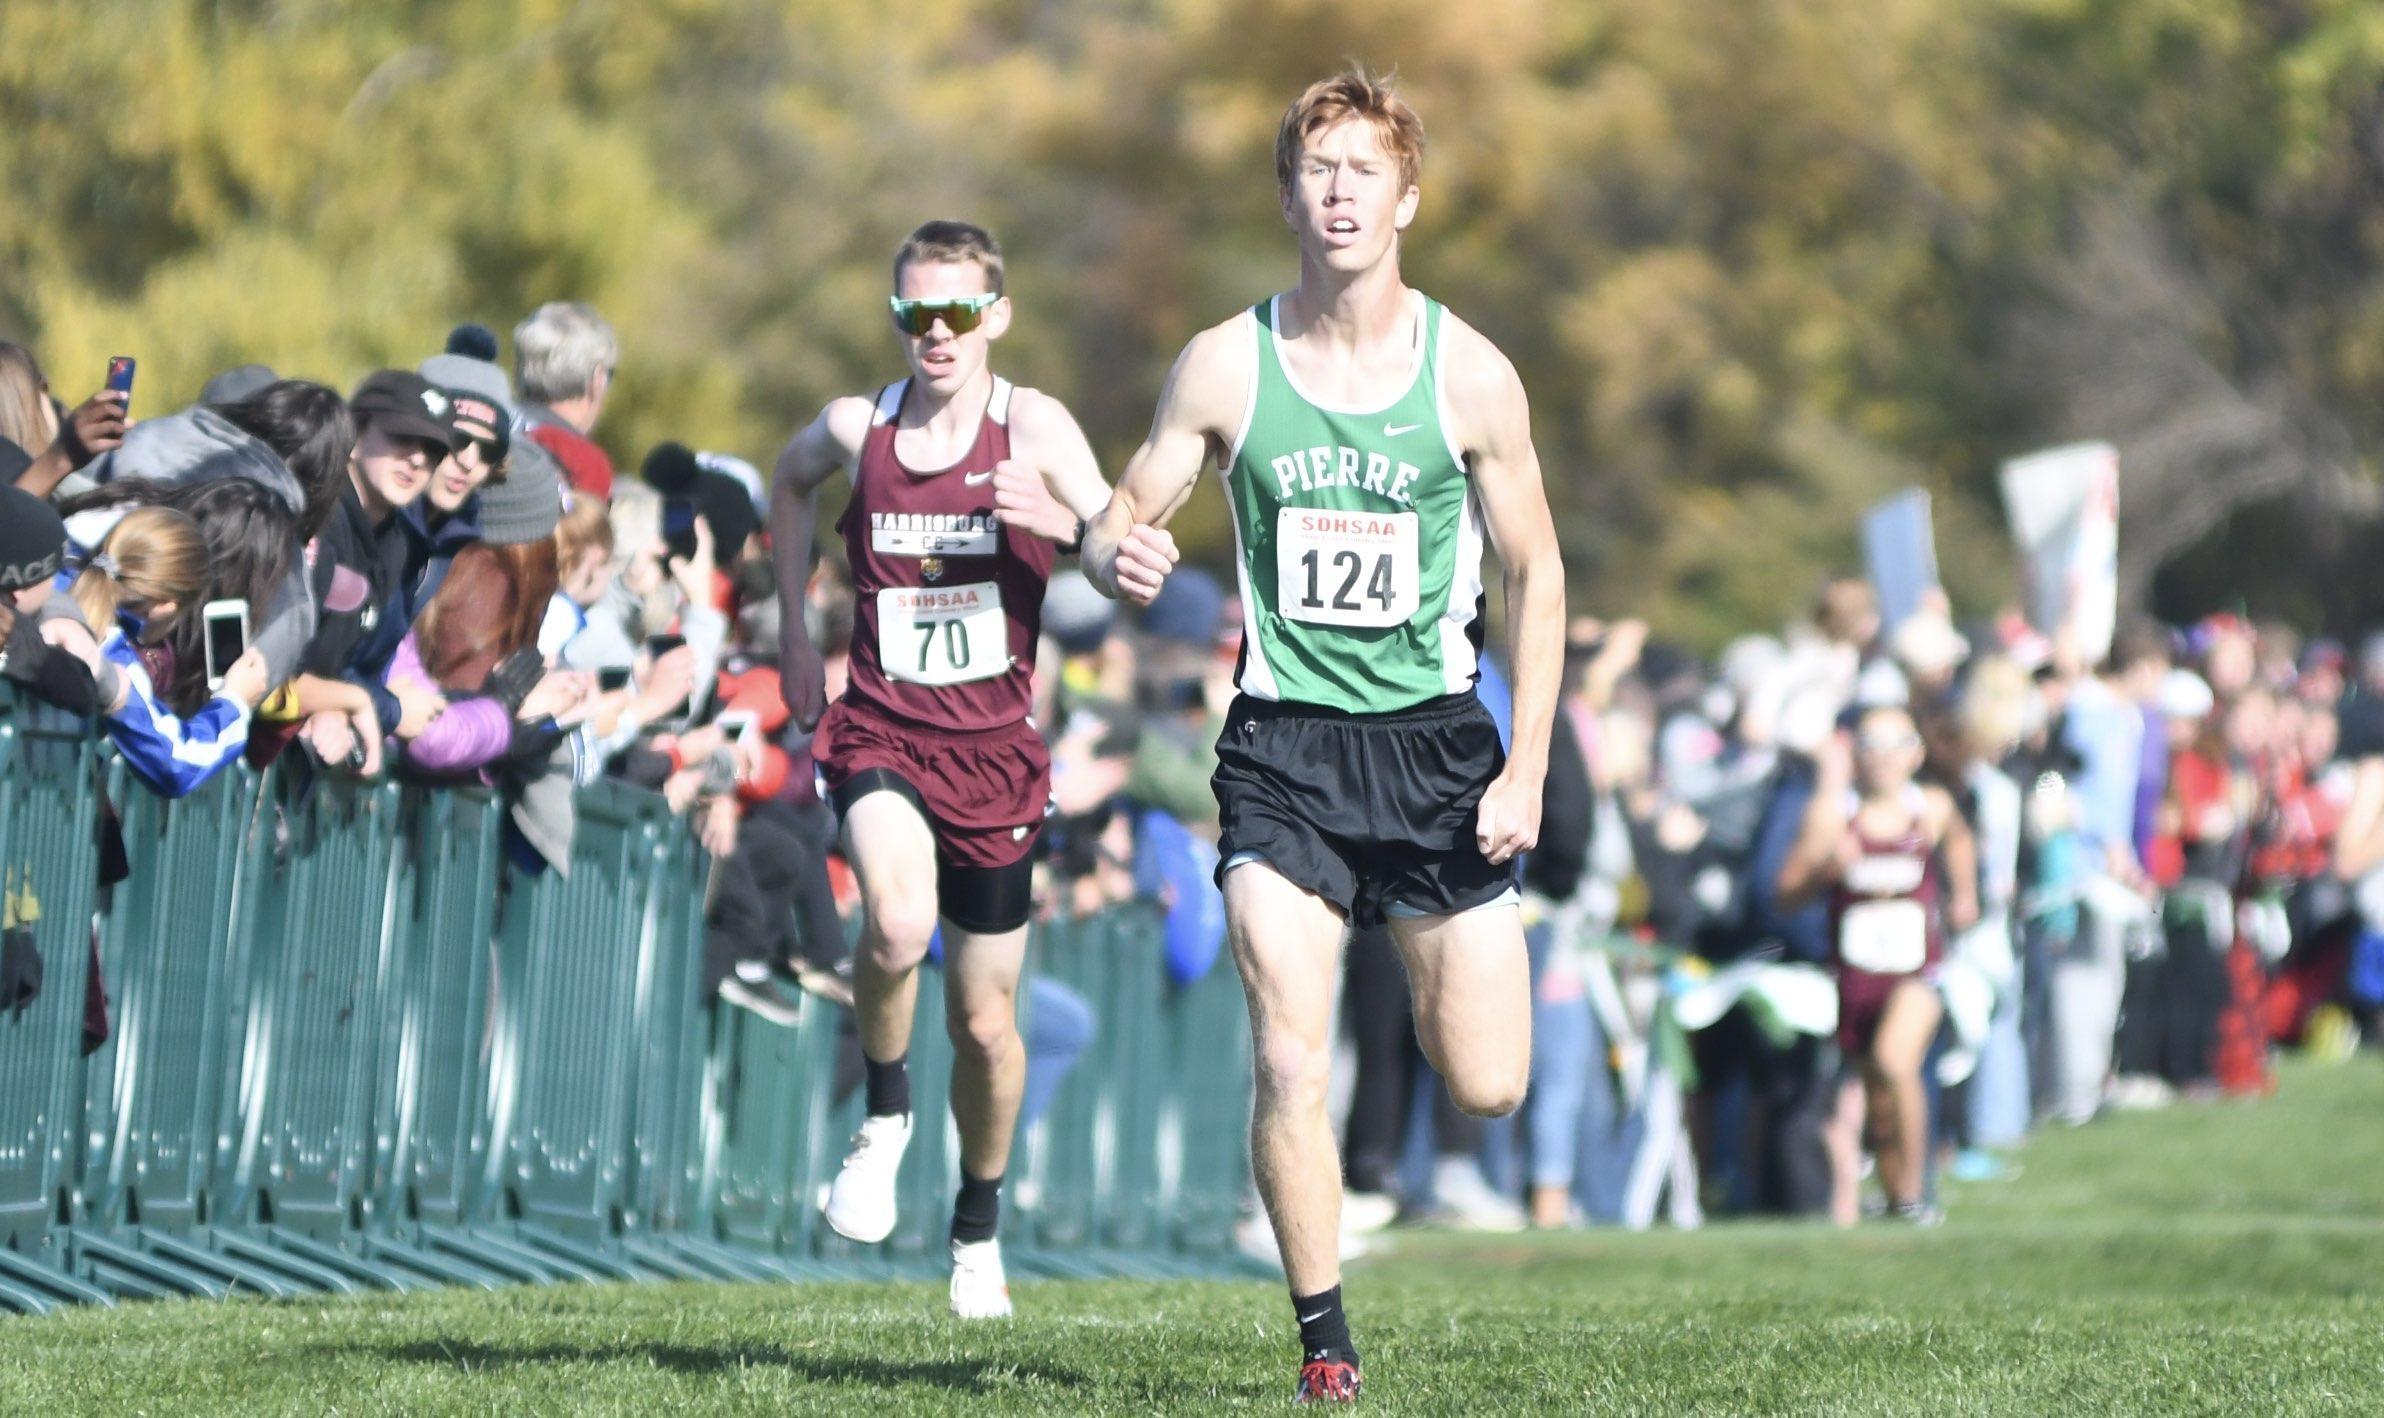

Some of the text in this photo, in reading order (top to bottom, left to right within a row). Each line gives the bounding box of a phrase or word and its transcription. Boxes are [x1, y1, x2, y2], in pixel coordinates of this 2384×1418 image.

[1271, 446, 1421, 502] PIERRE
[1301, 516, 1396, 535] SDHSAA
[897, 590, 979, 608] SDHSAA
[1301, 549, 1397, 612] 124
[912, 618, 970, 672] 70
